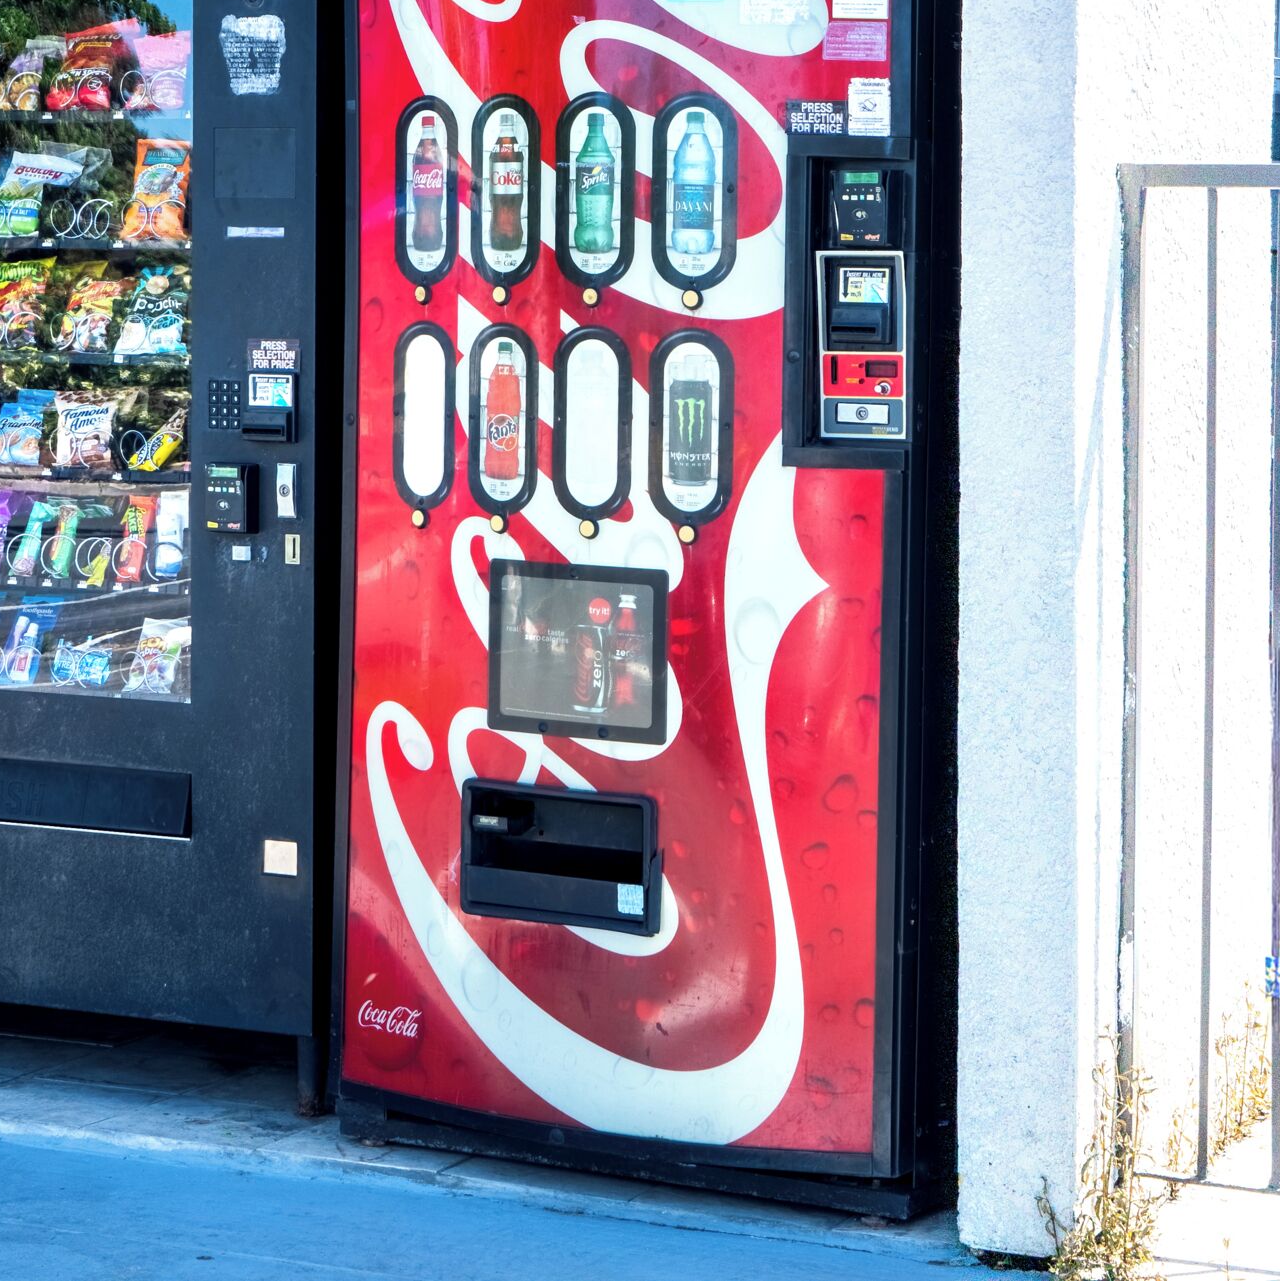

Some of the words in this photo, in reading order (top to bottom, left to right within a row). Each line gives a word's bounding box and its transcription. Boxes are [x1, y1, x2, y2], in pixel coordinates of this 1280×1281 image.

[801, 102, 833, 113] PRESS
[790, 113, 843, 123] SELECTION
[792, 123, 810, 132] FOR
[814, 124, 842, 133] PRICE
[413, 169, 443, 189] Coca-Cola
[491, 171, 521, 186] Coke
[582, 172, 608, 189] Sprite
[675, 201, 712, 213] DASANI
[261, 340, 287, 350] PRESS
[252, 350, 295, 360] SELECTION
[253, 359, 269, 369] FOR
[271, 359, 294, 369] PRICE
[61, 407, 109, 421] Famous
[670, 451, 711, 462] MONSTER
[21, 606, 55, 615] Toothpaste
[589, 607, 601, 616] try
[601, 606, 610, 615] it!
[547, 628, 565, 637] taste
[542, 634, 569, 644] calories
[592, 649, 603, 688] zero
[358, 999, 422, 1039] Coca-Cola
